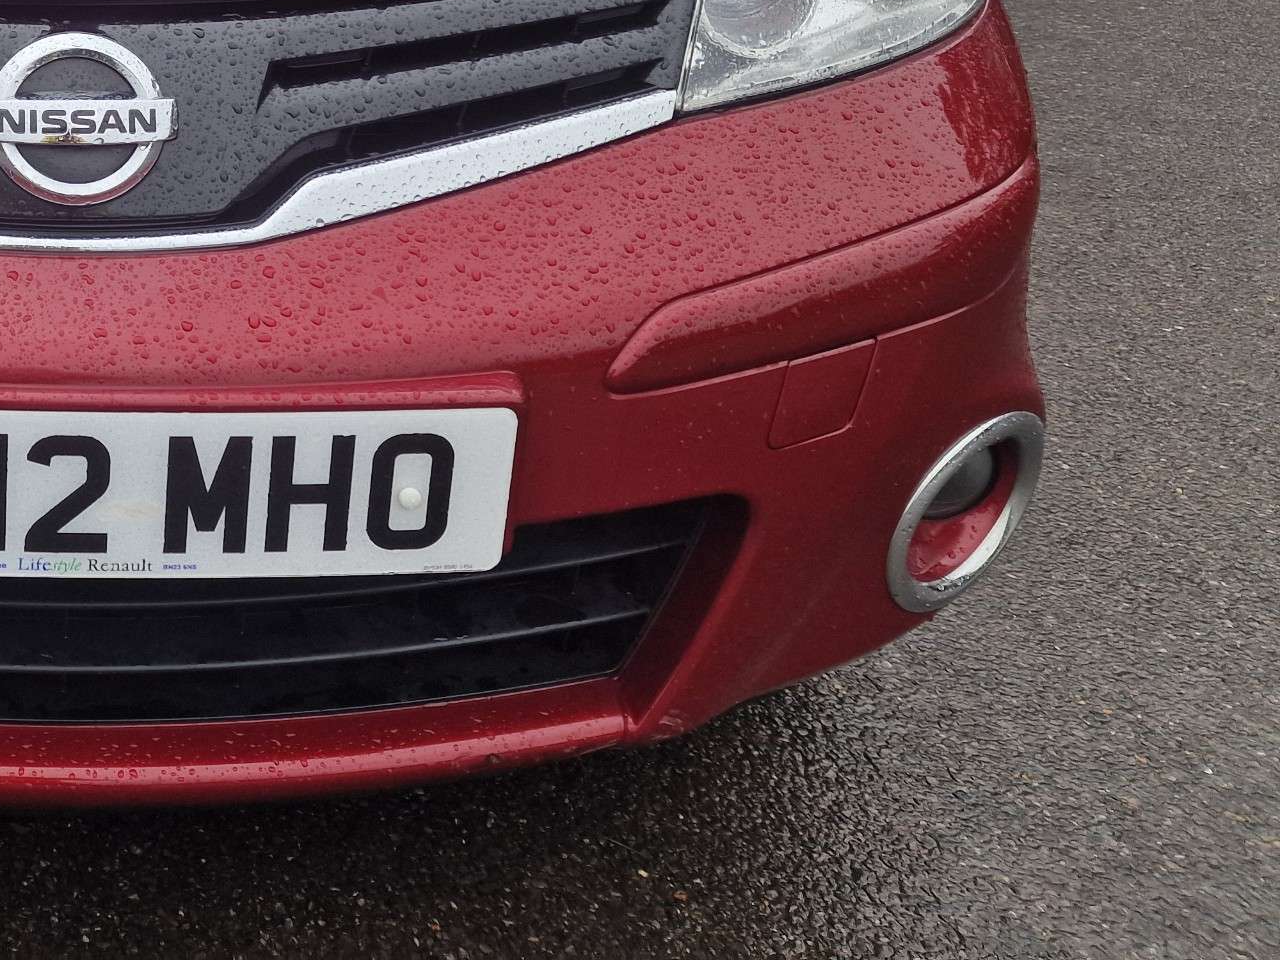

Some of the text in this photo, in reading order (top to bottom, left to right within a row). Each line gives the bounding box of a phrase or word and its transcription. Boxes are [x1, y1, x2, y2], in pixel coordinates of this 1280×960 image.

[163, 432, 456, 553] MHO
[18, 557, 83, 575] Lifestyle
[87, 558, 153, 572] Renault
